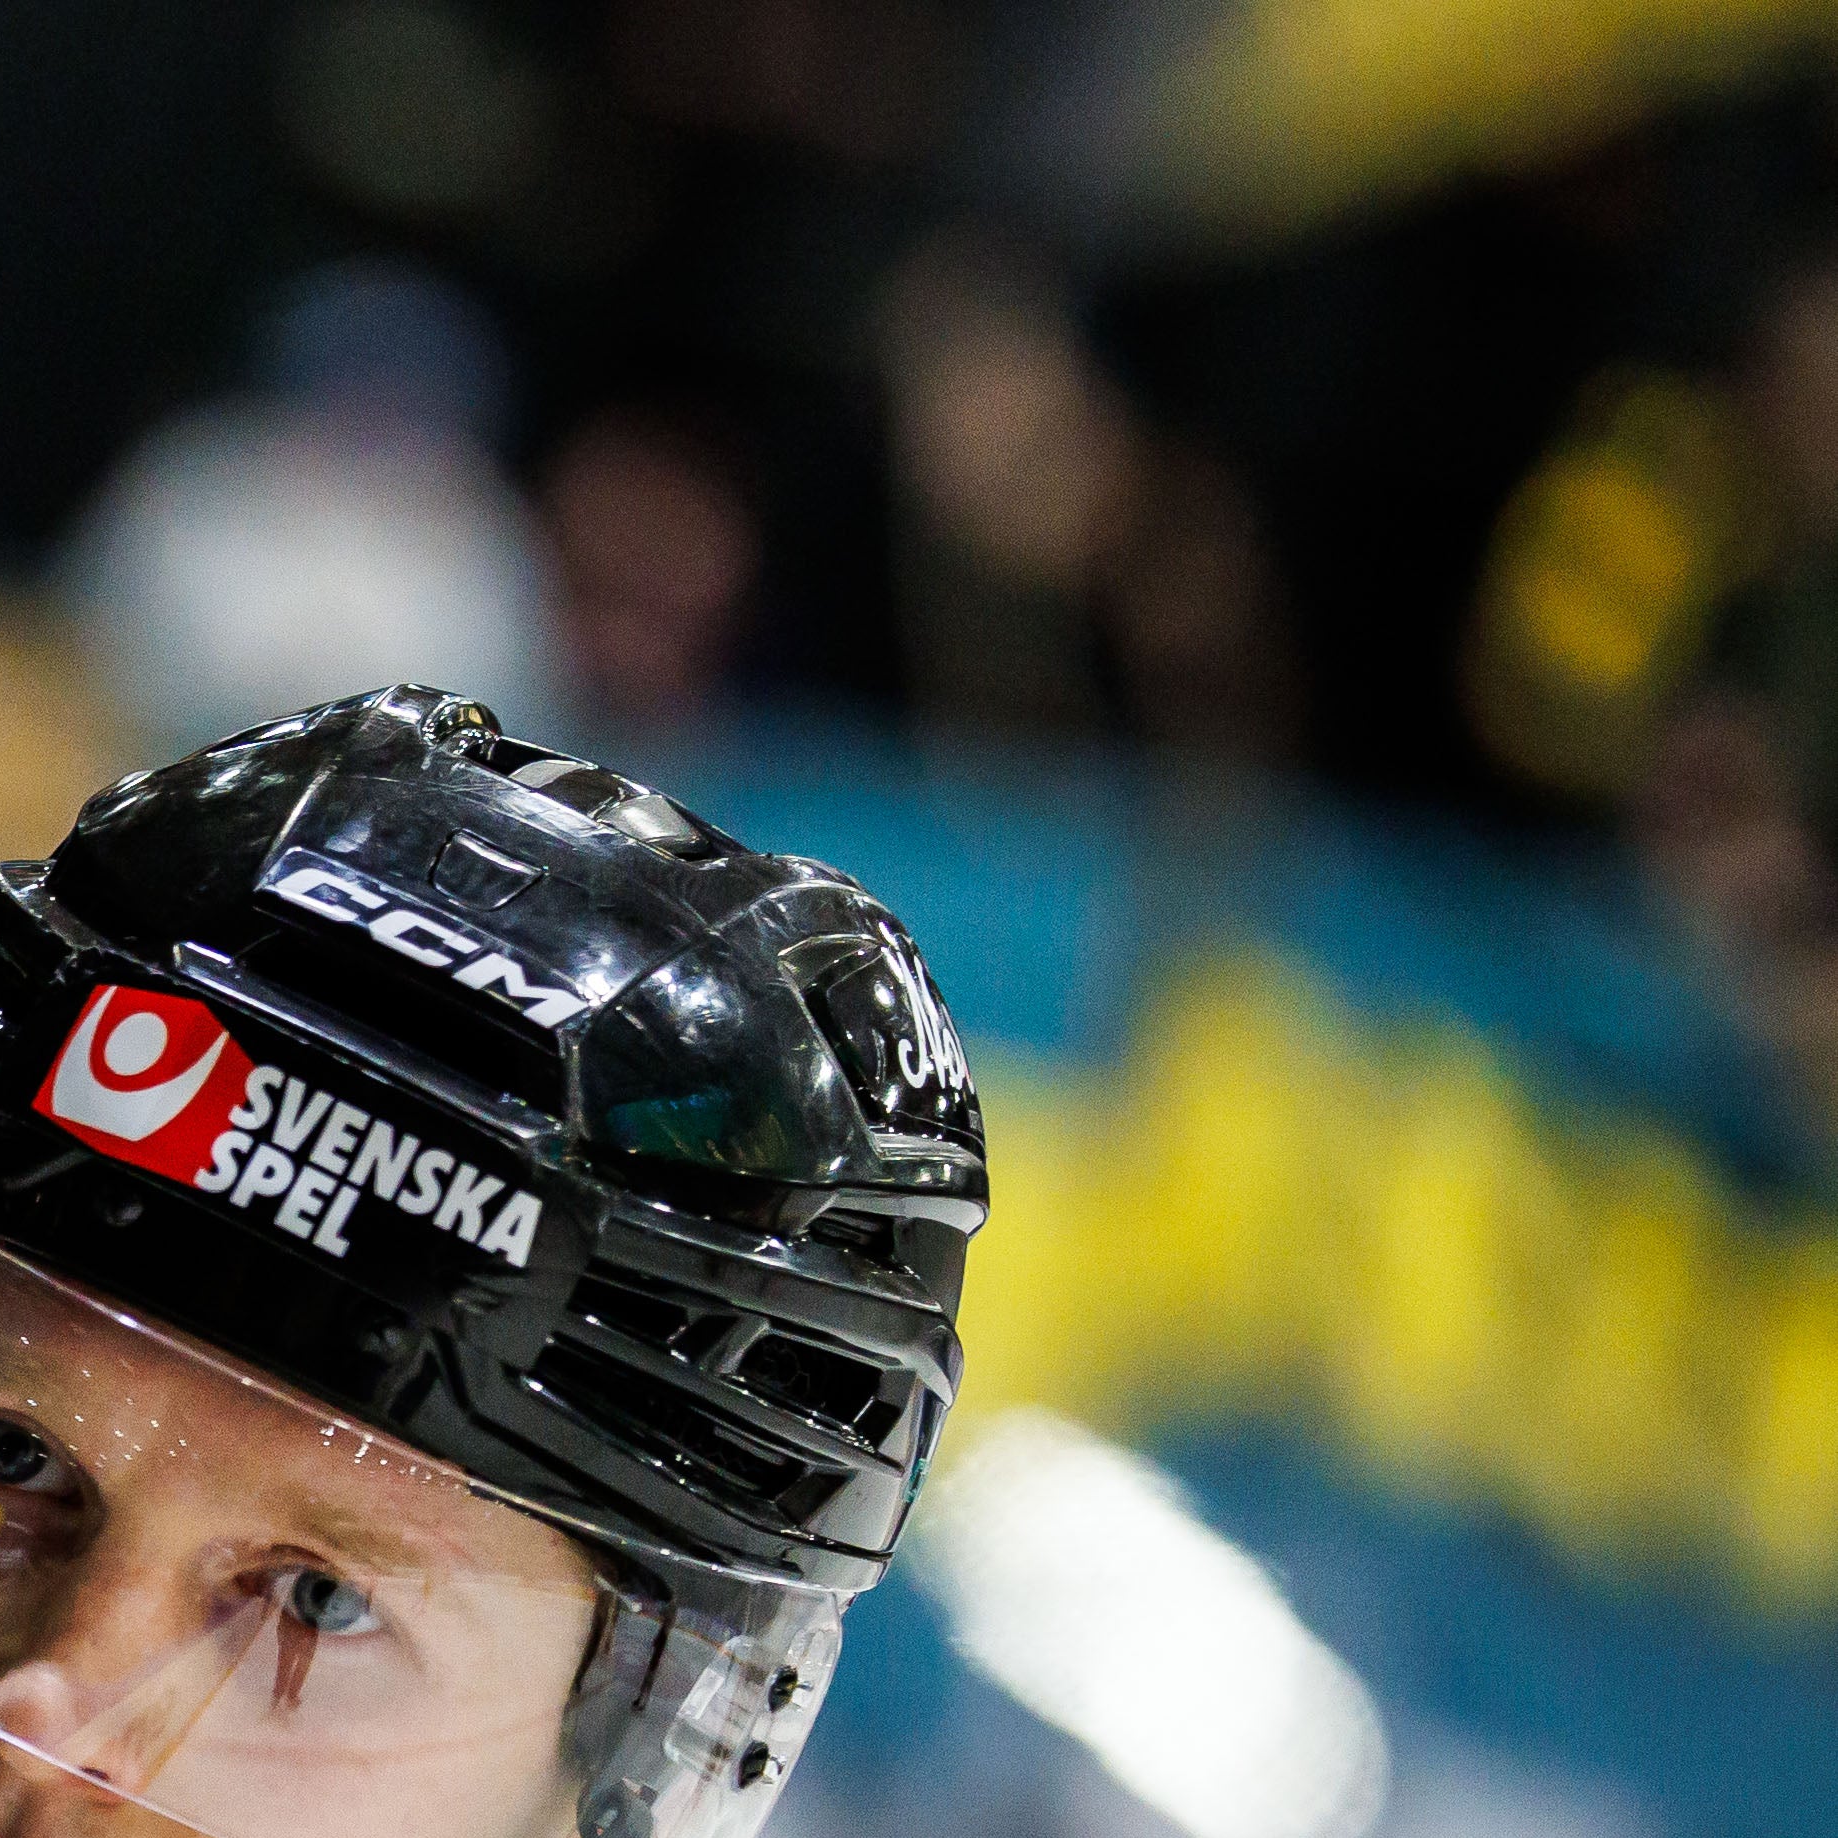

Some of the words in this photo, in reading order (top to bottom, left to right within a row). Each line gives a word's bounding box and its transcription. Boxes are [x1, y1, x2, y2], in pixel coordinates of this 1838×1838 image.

[265, 866, 597, 1030] CCM
[195, 1129, 360, 1258] SPEL
[229, 1065, 542, 1268] SVENSKA
